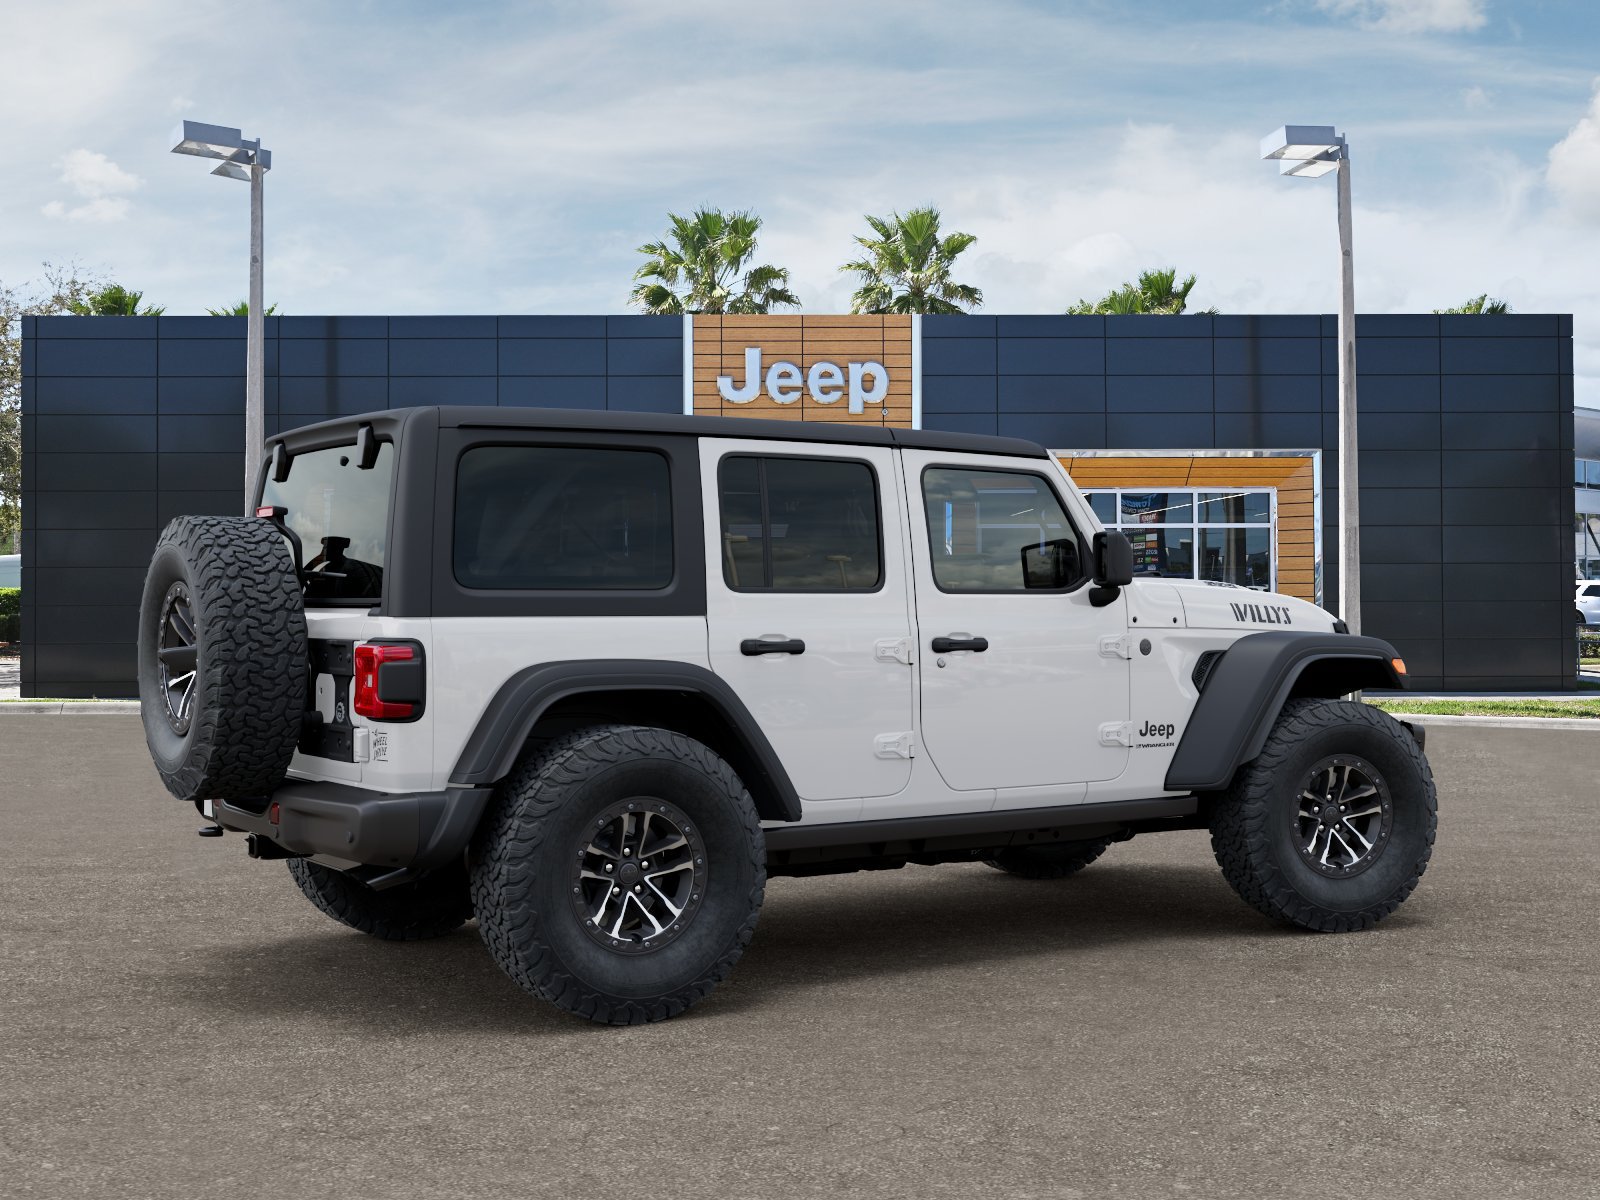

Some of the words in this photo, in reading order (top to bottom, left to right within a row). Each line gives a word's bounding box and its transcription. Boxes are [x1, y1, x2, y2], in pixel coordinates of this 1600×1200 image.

[717, 347, 889, 415] Jeep
[1230, 602, 1292, 625] WILLYS
[1139, 720, 1175, 739] Jeep
